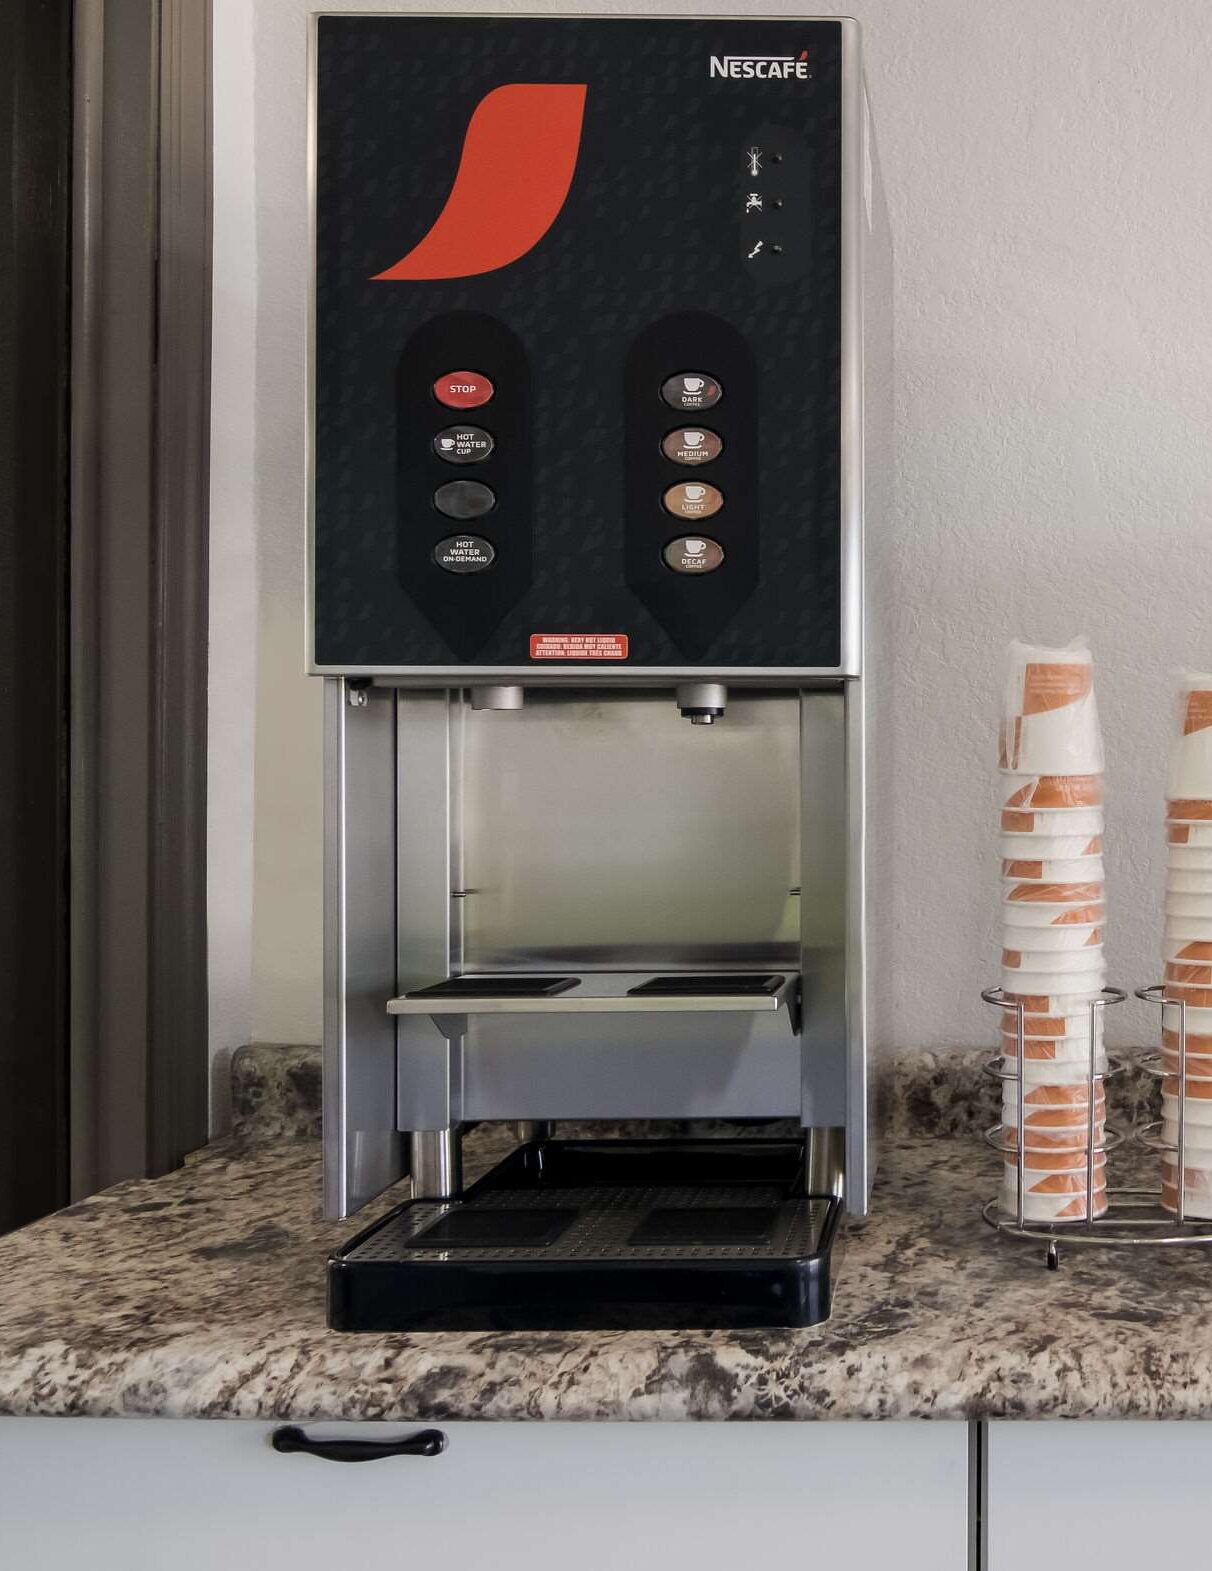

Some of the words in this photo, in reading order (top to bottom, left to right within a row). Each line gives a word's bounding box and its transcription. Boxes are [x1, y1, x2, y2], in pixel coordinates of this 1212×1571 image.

[710, 51, 809, 78] NESCAFÉ
[450, 385, 477, 393] STOP
[456, 433, 475, 441] HOT
[450, 548, 480, 556] WATER
